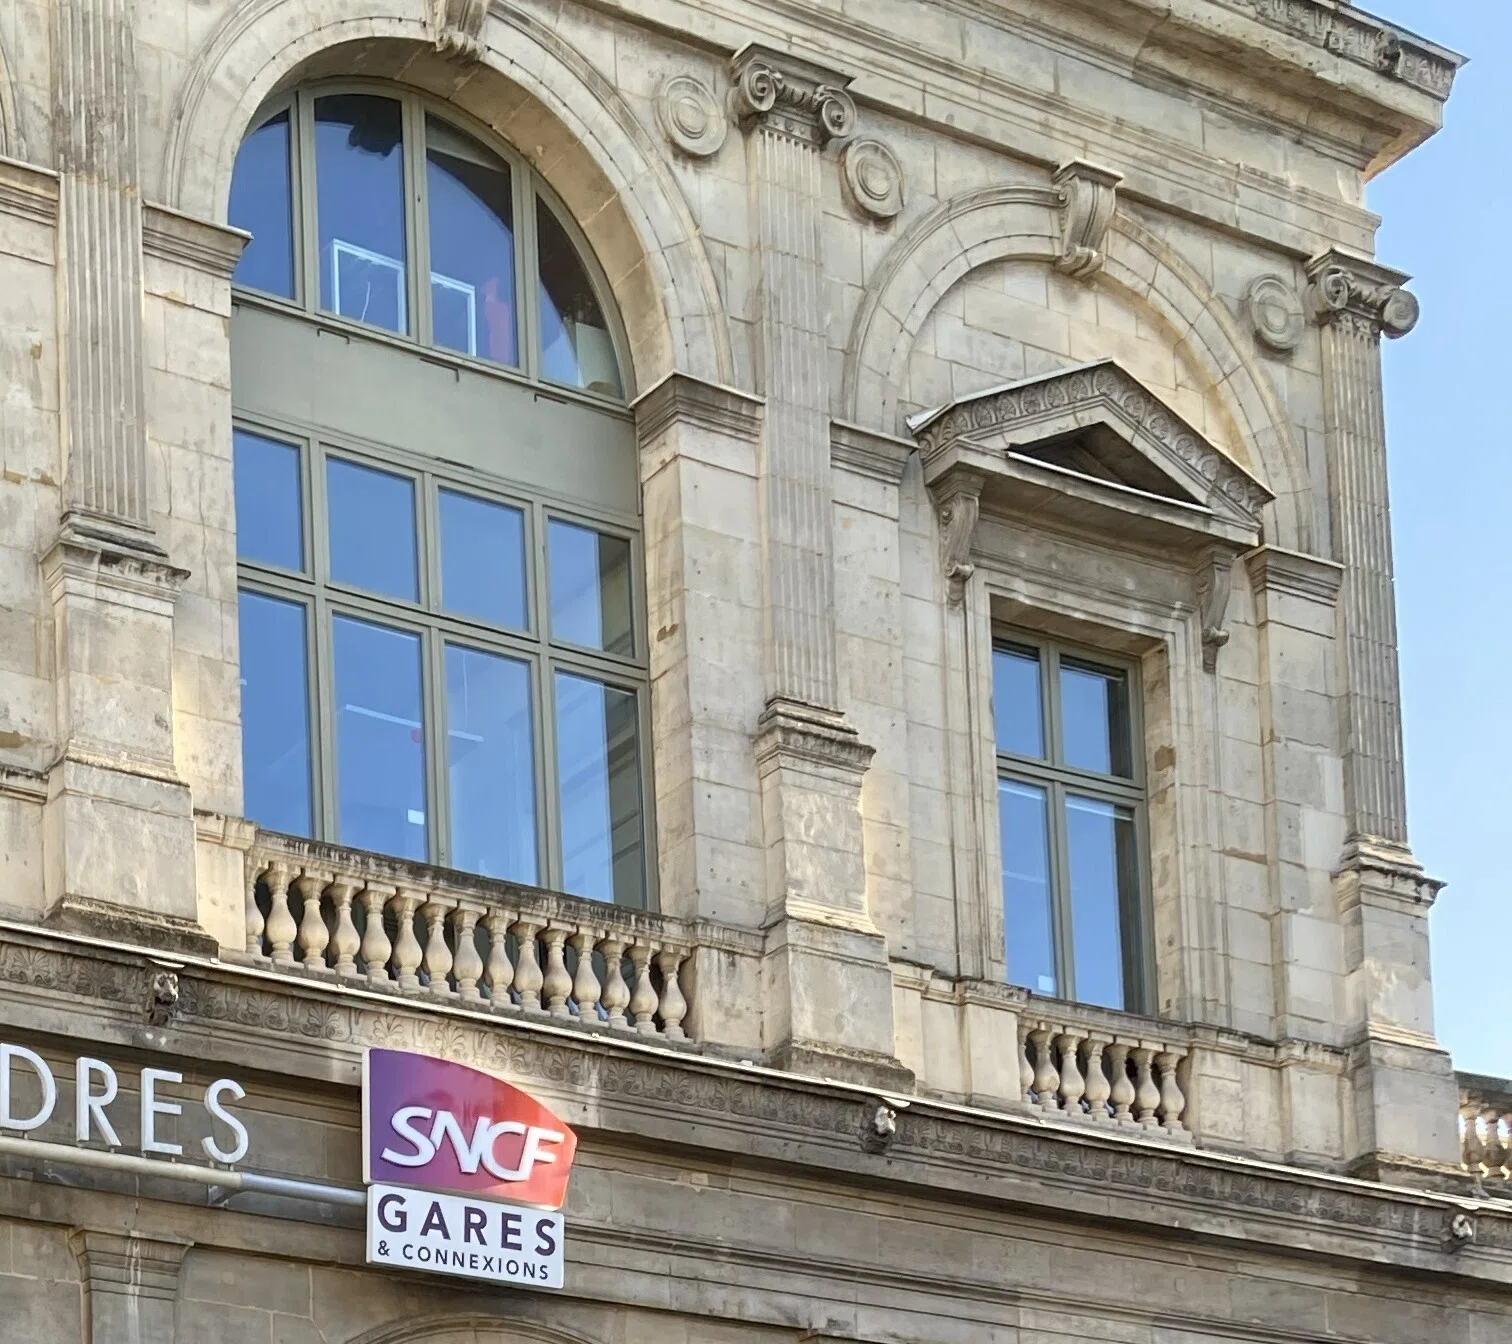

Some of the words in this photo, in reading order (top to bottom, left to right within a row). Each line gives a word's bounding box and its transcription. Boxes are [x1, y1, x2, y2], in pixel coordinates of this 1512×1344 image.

[380, 1105, 565, 1182] SNCF
[377, 1193, 556, 1257] GARES
[377, 1240, 390, 1257] &
[402, 1243, 549, 1281] CONNEXIONS
